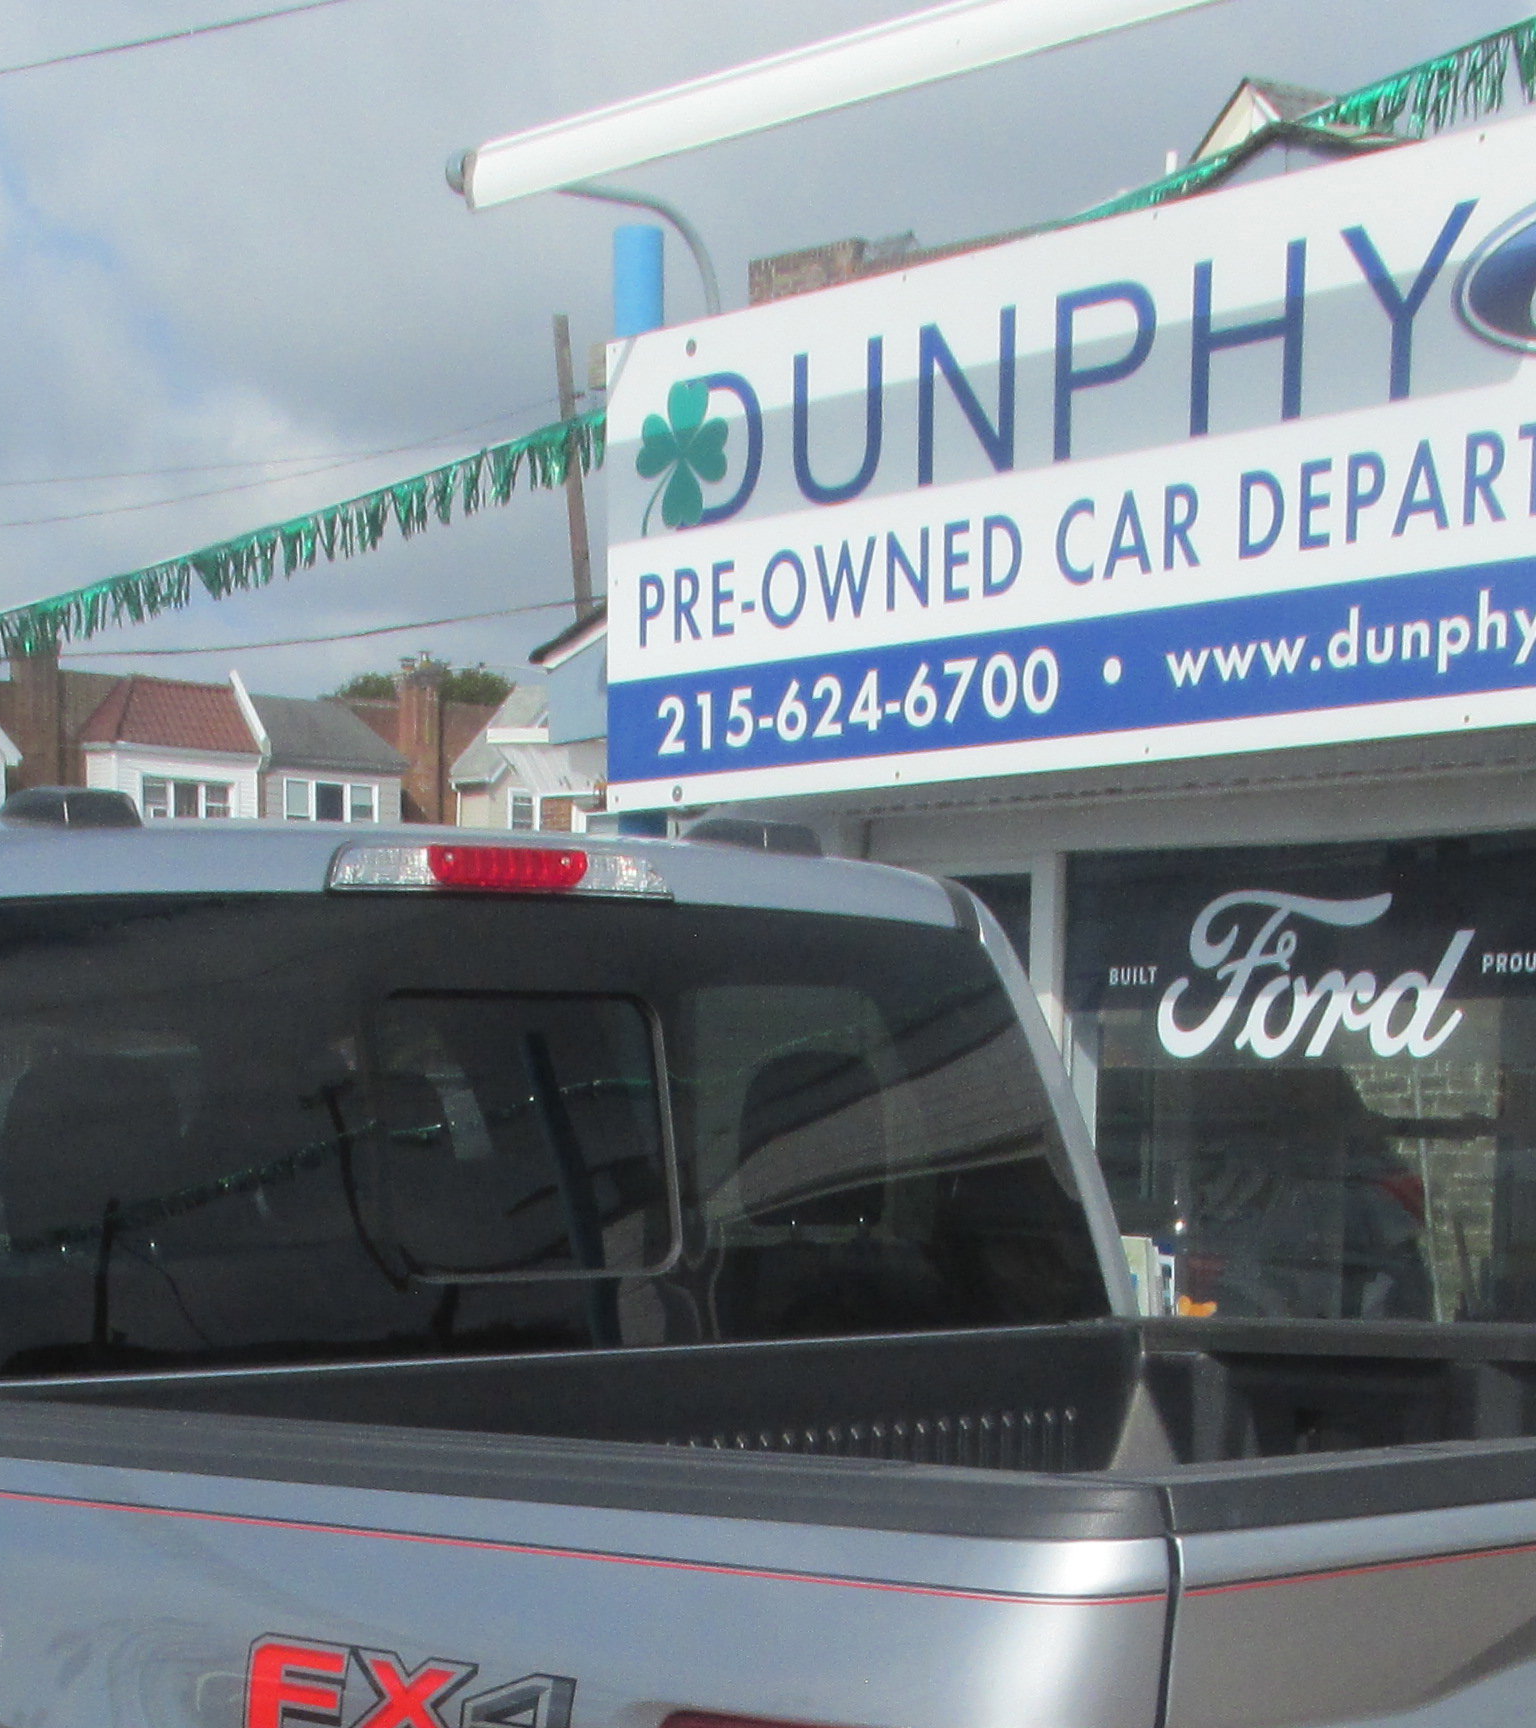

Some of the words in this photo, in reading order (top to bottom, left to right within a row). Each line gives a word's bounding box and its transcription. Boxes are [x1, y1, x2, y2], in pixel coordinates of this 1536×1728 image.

[669, 196, 1480, 531] DUNPHY
[638, 513, 1023, 649] PRE-OWNED
[1054, 482, 1200, 586] CAR
[657, 646, 1060, 757] 215-624-6700
[1108, 966, 1159, 986] BUILT
[1156, 889, 1476, 1060] Ford
